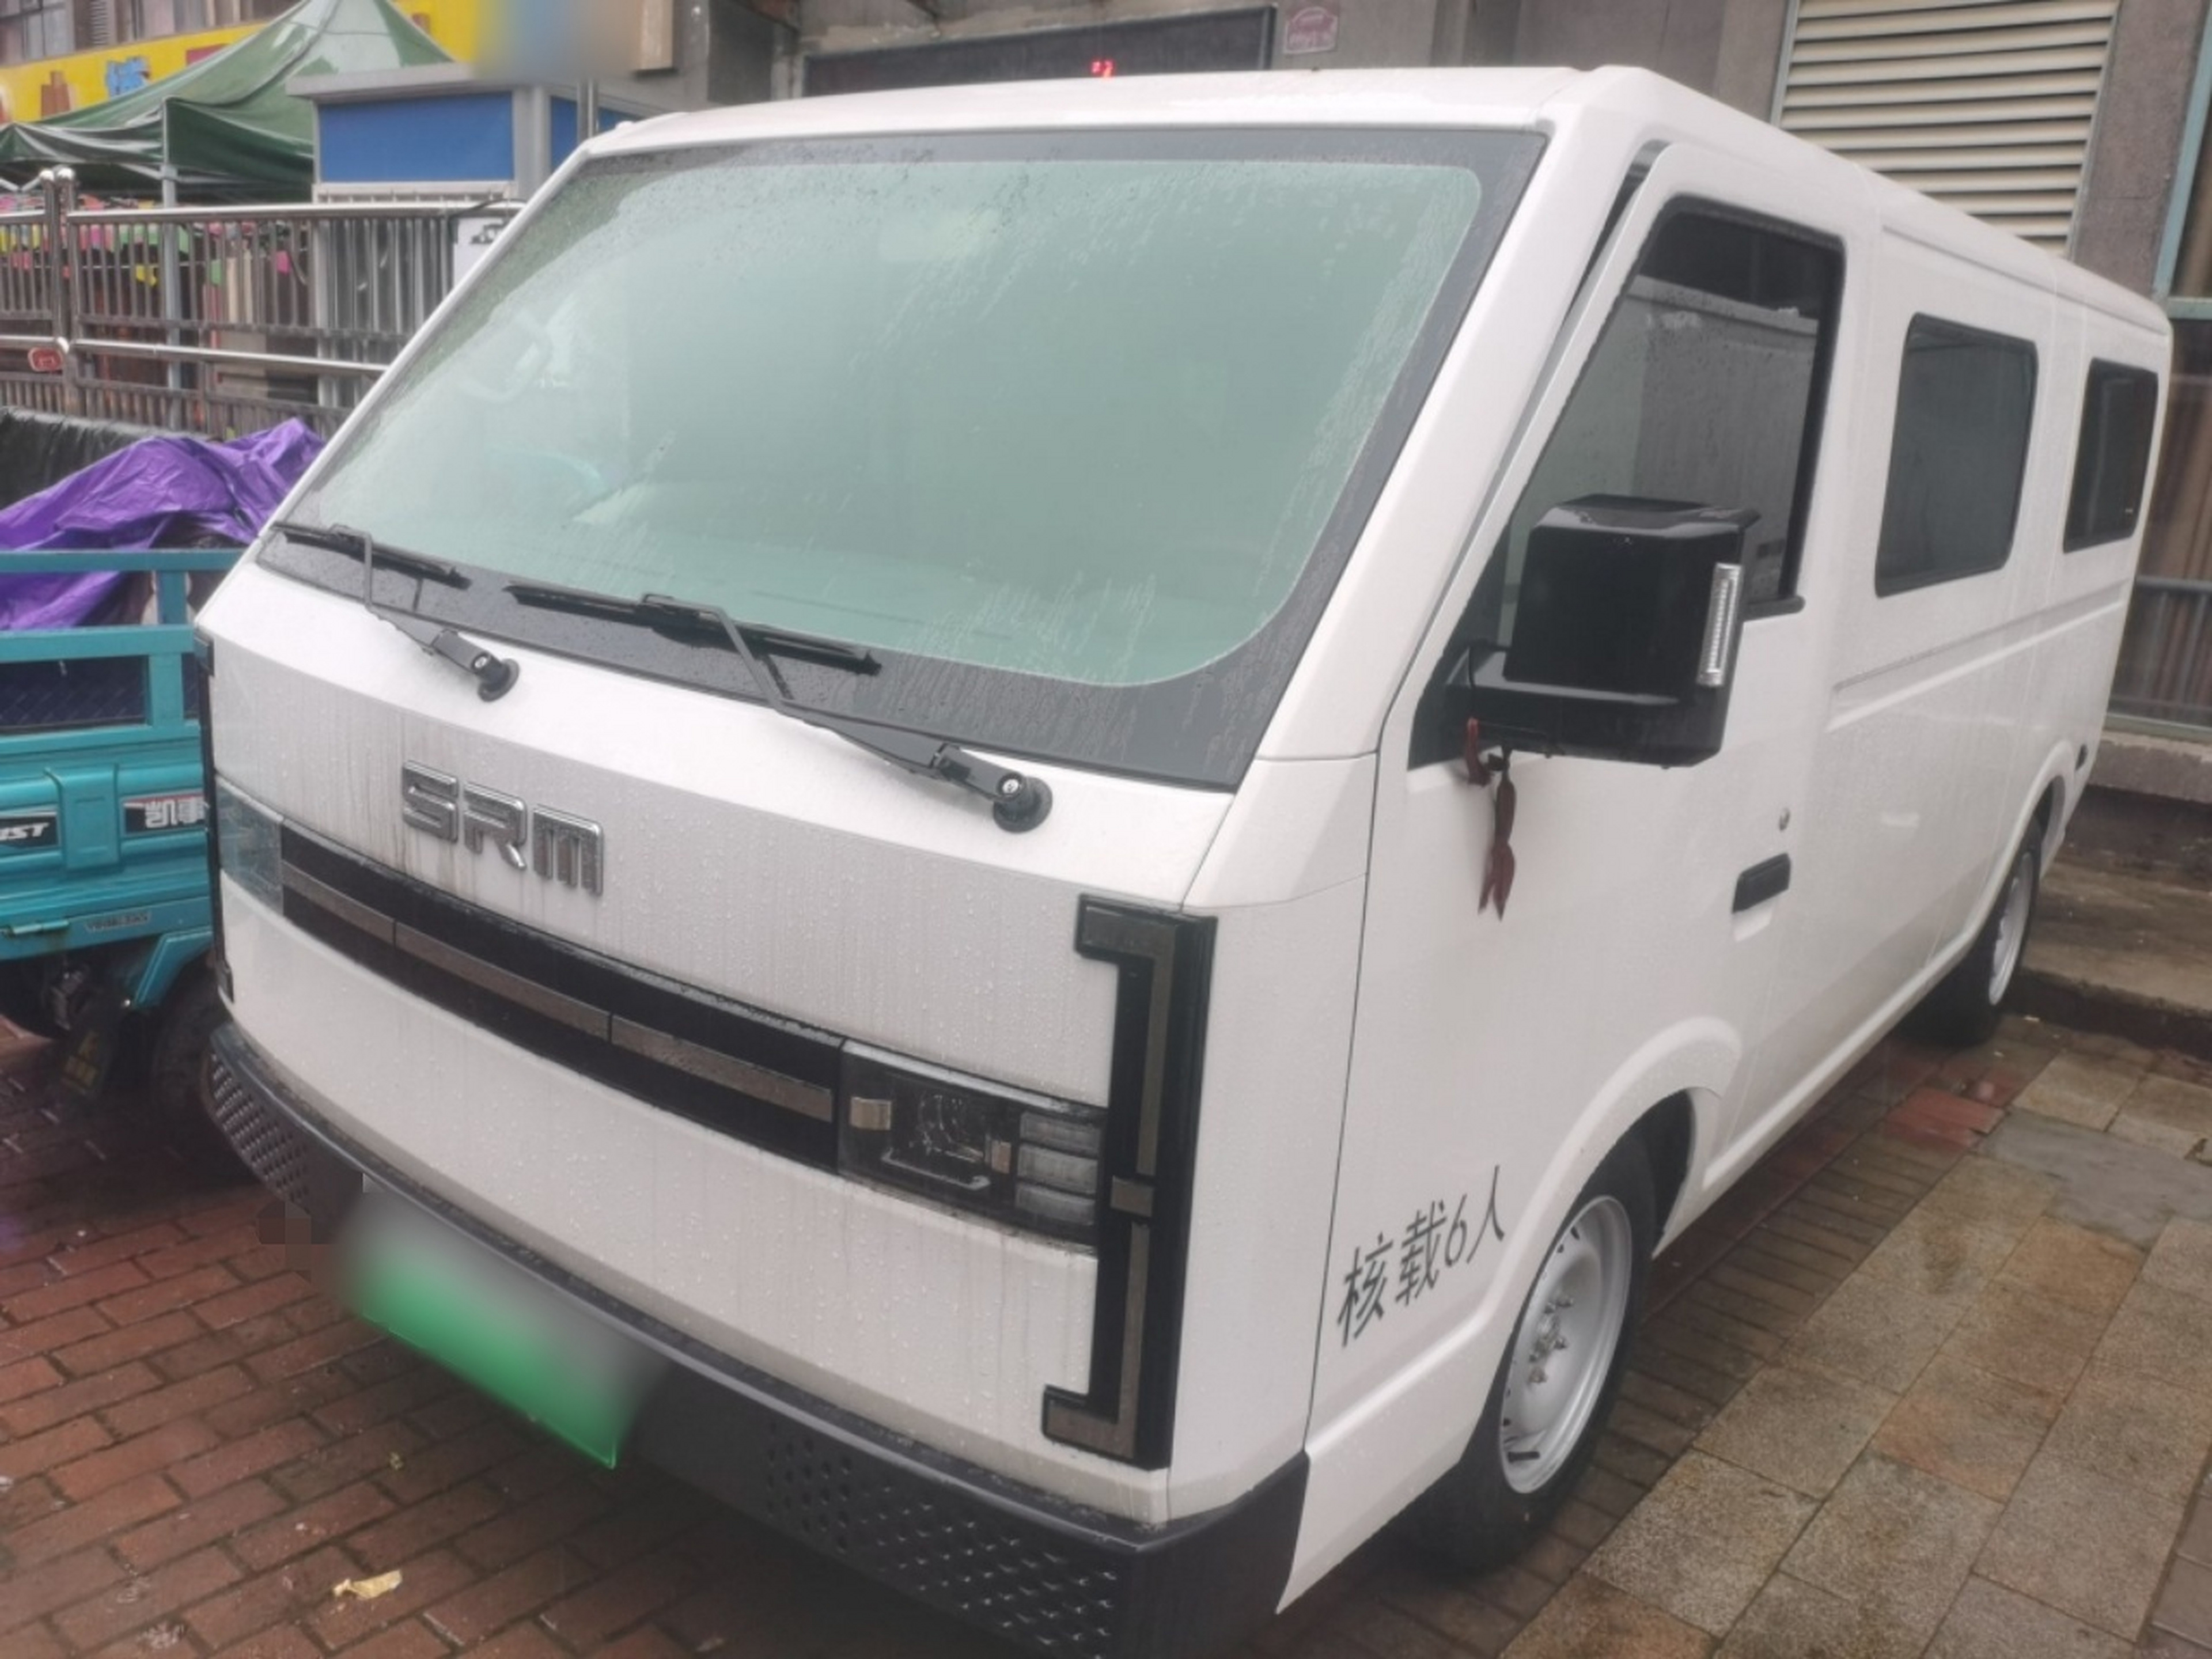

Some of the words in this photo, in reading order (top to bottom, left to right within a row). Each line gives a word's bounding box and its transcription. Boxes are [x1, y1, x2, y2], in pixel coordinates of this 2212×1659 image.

[402, 759, 605, 896] SRM
[1336, 1164, 1505, 1349] 核载6人
